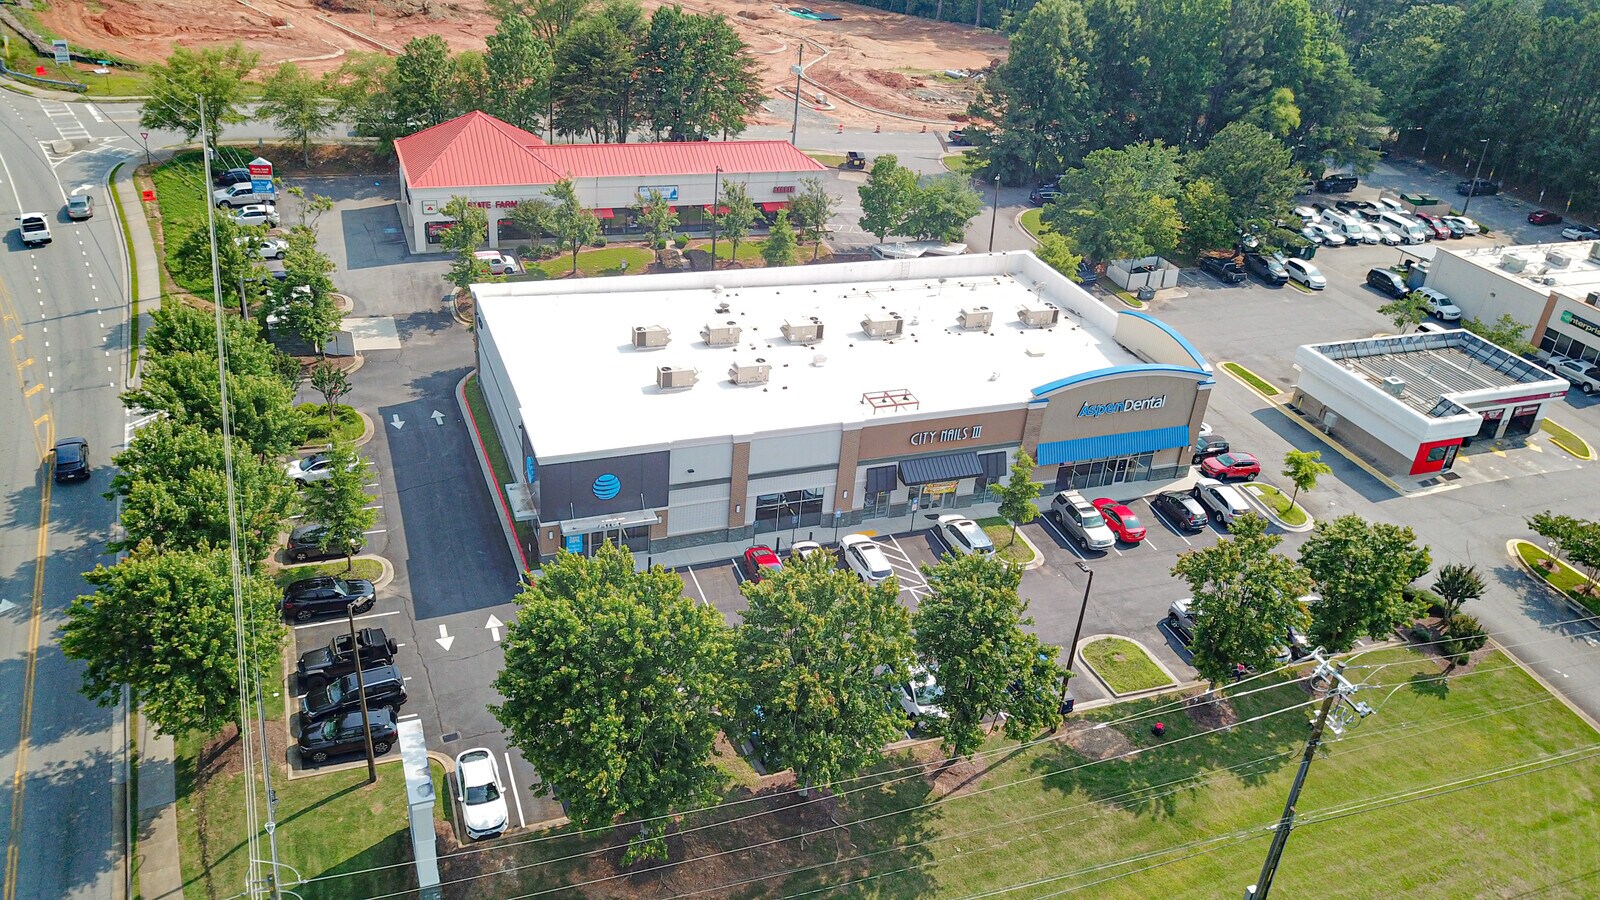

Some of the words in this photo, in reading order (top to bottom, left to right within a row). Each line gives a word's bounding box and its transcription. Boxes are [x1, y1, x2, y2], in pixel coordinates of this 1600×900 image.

[467, 201, 491, 209] STATE
[495, 200, 518, 209] FARM
[910, 431, 937, 446] CITY
[939, 427, 969, 443] NAILS
[971, 425, 983, 439] III
